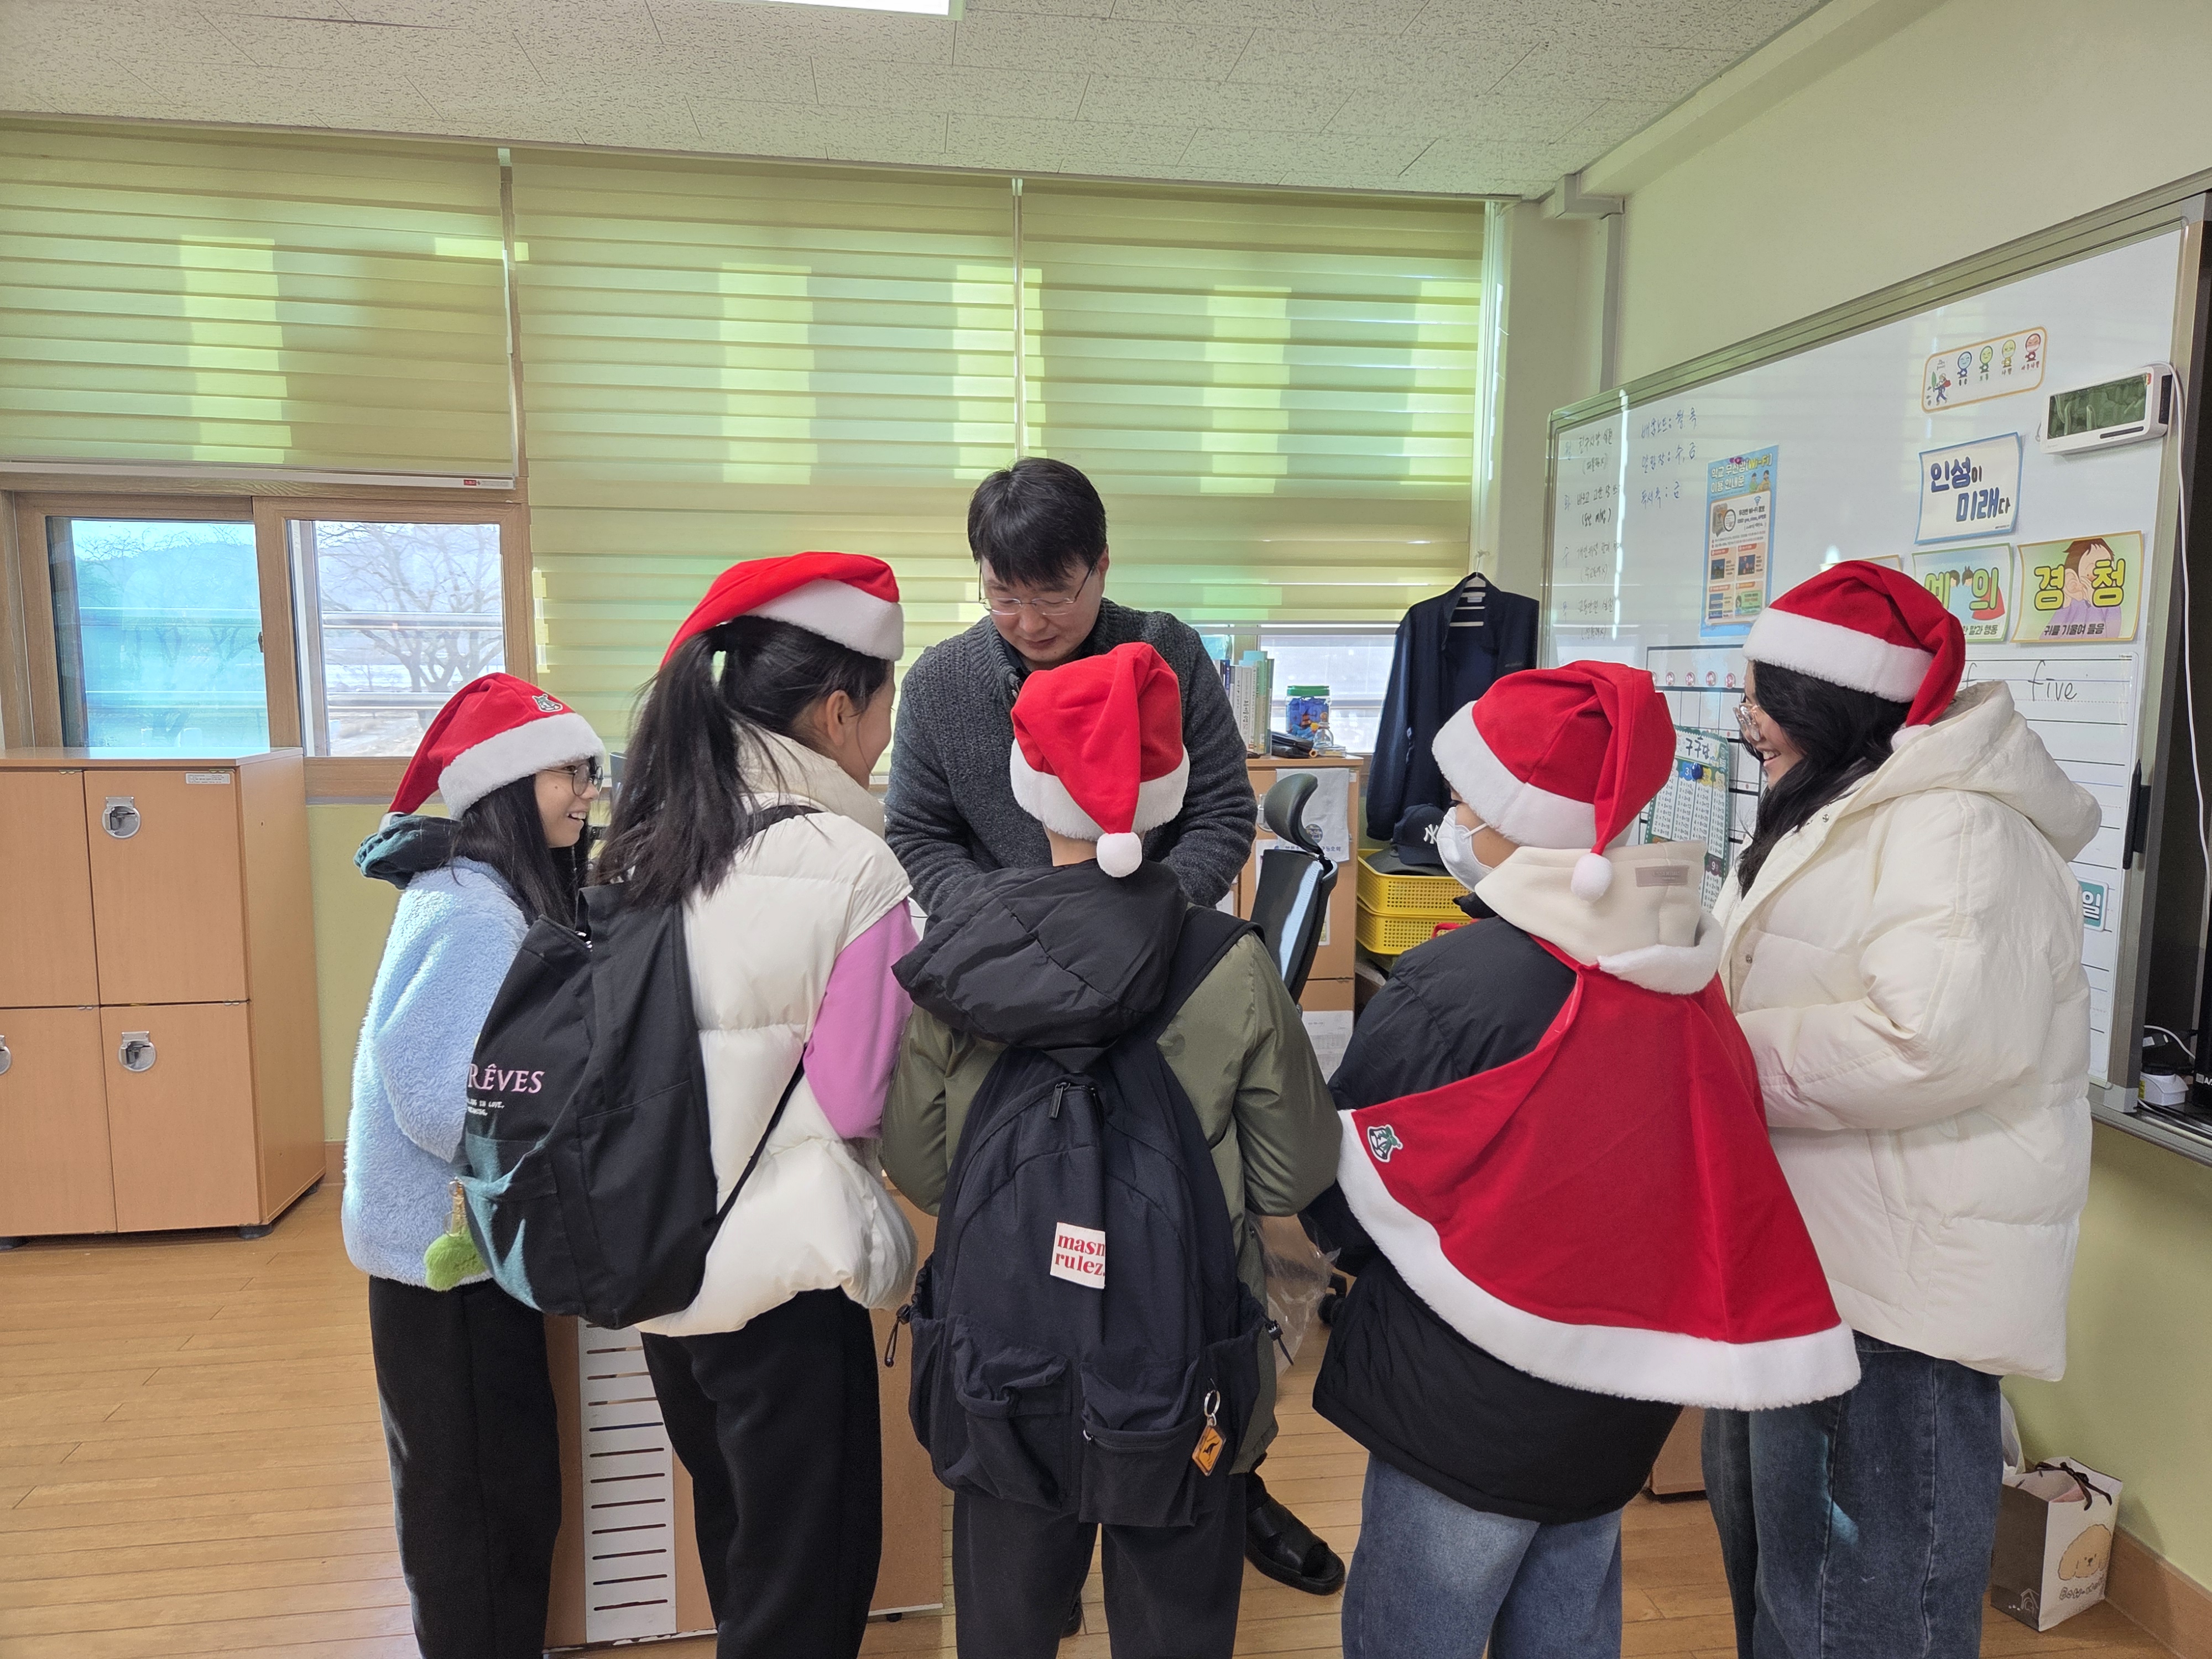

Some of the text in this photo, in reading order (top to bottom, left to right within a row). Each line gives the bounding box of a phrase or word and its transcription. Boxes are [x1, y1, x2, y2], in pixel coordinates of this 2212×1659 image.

[1711, 476, 1745, 493] 이용 안내문
[1712, 467, 1724, 478] 학교
[1931, 456, 1982, 493] 인성이
[1956, 487, 2011, 522] 미래다
[2034, 559, 2126, 611] 경청
[1969, 625, 1984, 635] 말과
[1984, 624, 1998, 635] 행동
[2044, 623, 2104, 635] 귀를 기울여 들음
[2028, 660, 2078, 702] five
[1686, 737, 1710, 760] 구구단
[2082, 891, 2101, 919] 일
[468, 1063, 545, 1093] RÊVES
